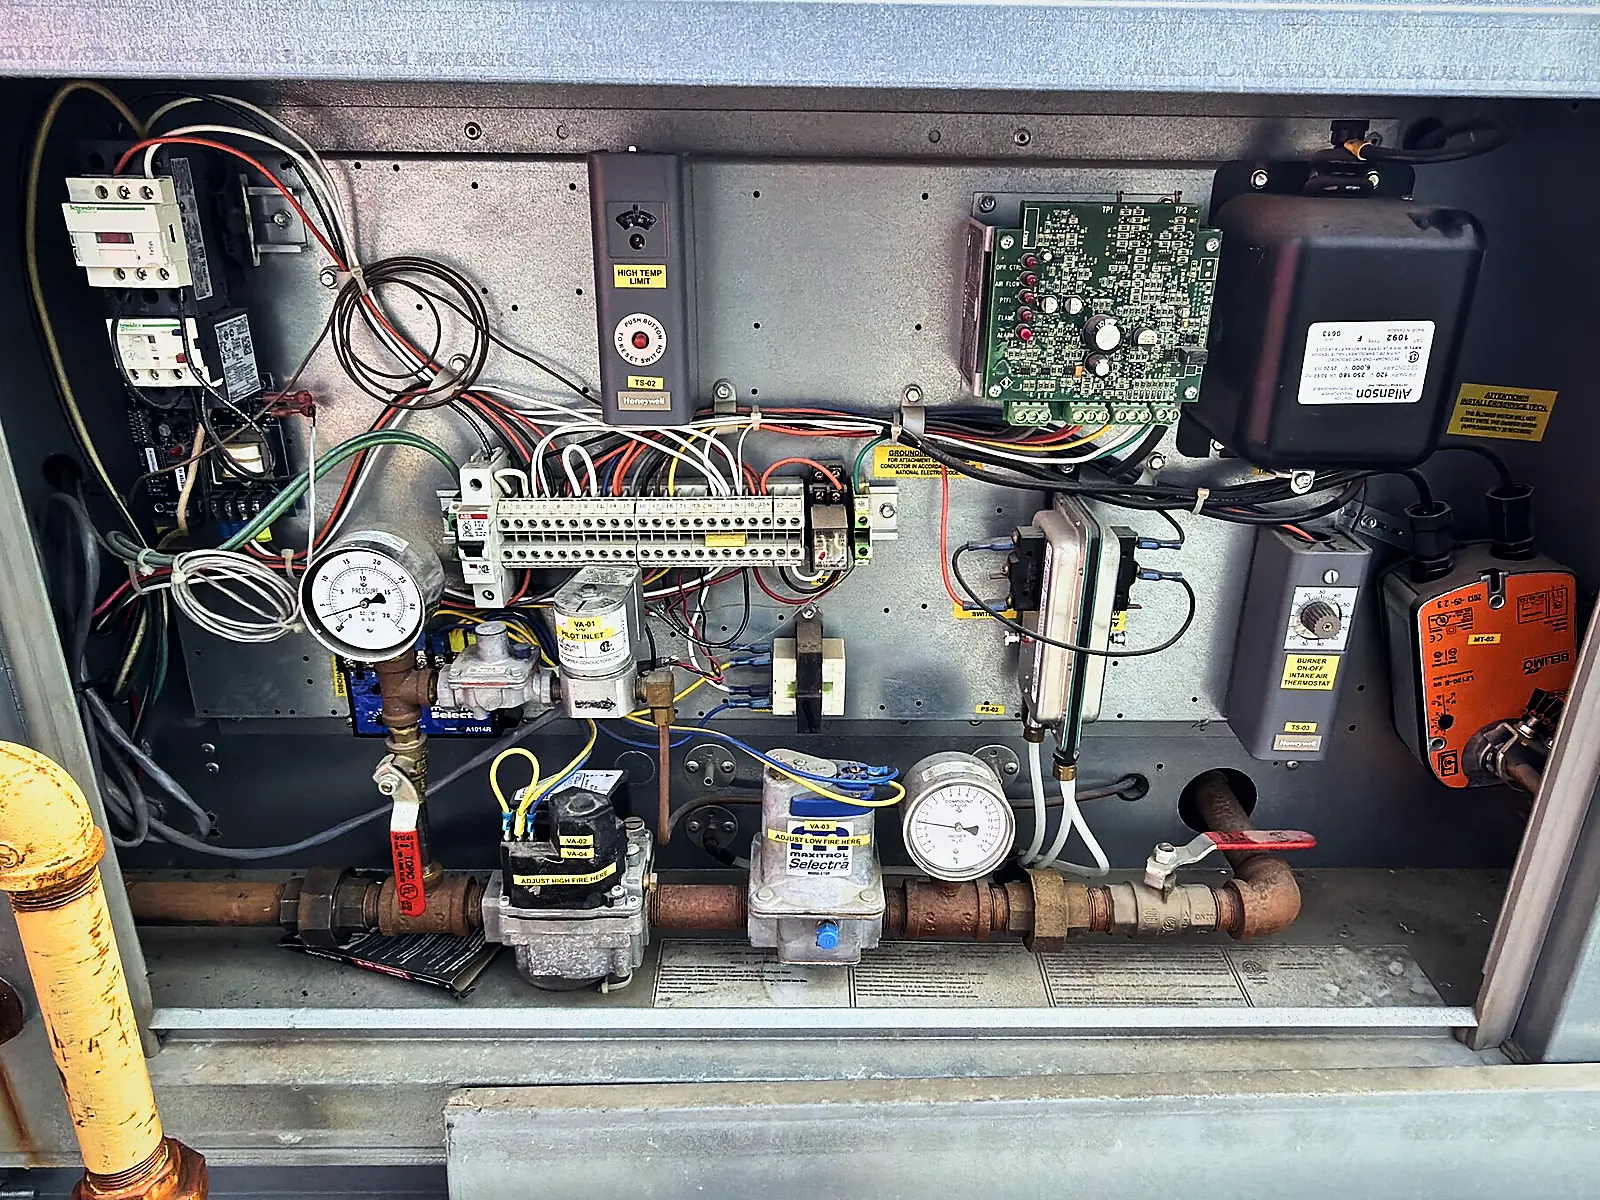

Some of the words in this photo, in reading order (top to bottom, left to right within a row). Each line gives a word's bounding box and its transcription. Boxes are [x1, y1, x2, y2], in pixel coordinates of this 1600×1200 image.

[1103, 205, 1114, 214] TP1
[1175, 206, 1187, 214] TP2
[624, 318, 641, 327] PUSH
[642, 318, 663, 340] BUTTON
[618, 332, 624, 341] TO
[619, 343, 638, 363] RESET
[641, 345, 663, 363] SWITCH
[634, 379, 656, 387] TS-02
[1356, 388, 1412, 399] Allanson
[623, 397, 665, 405] Honeywell
[1522, 652, 1570, 671] BELIMO
[431, 711, 474, 719] Select
[1279, 739, 1318, 747] Honeywell
[775, 834, 803, 843] ADJUST
[405, 856, 415, 880] TOPIC
[789, 858, 849, 870] Selectra
[590, 870, 608, 882] HERE
